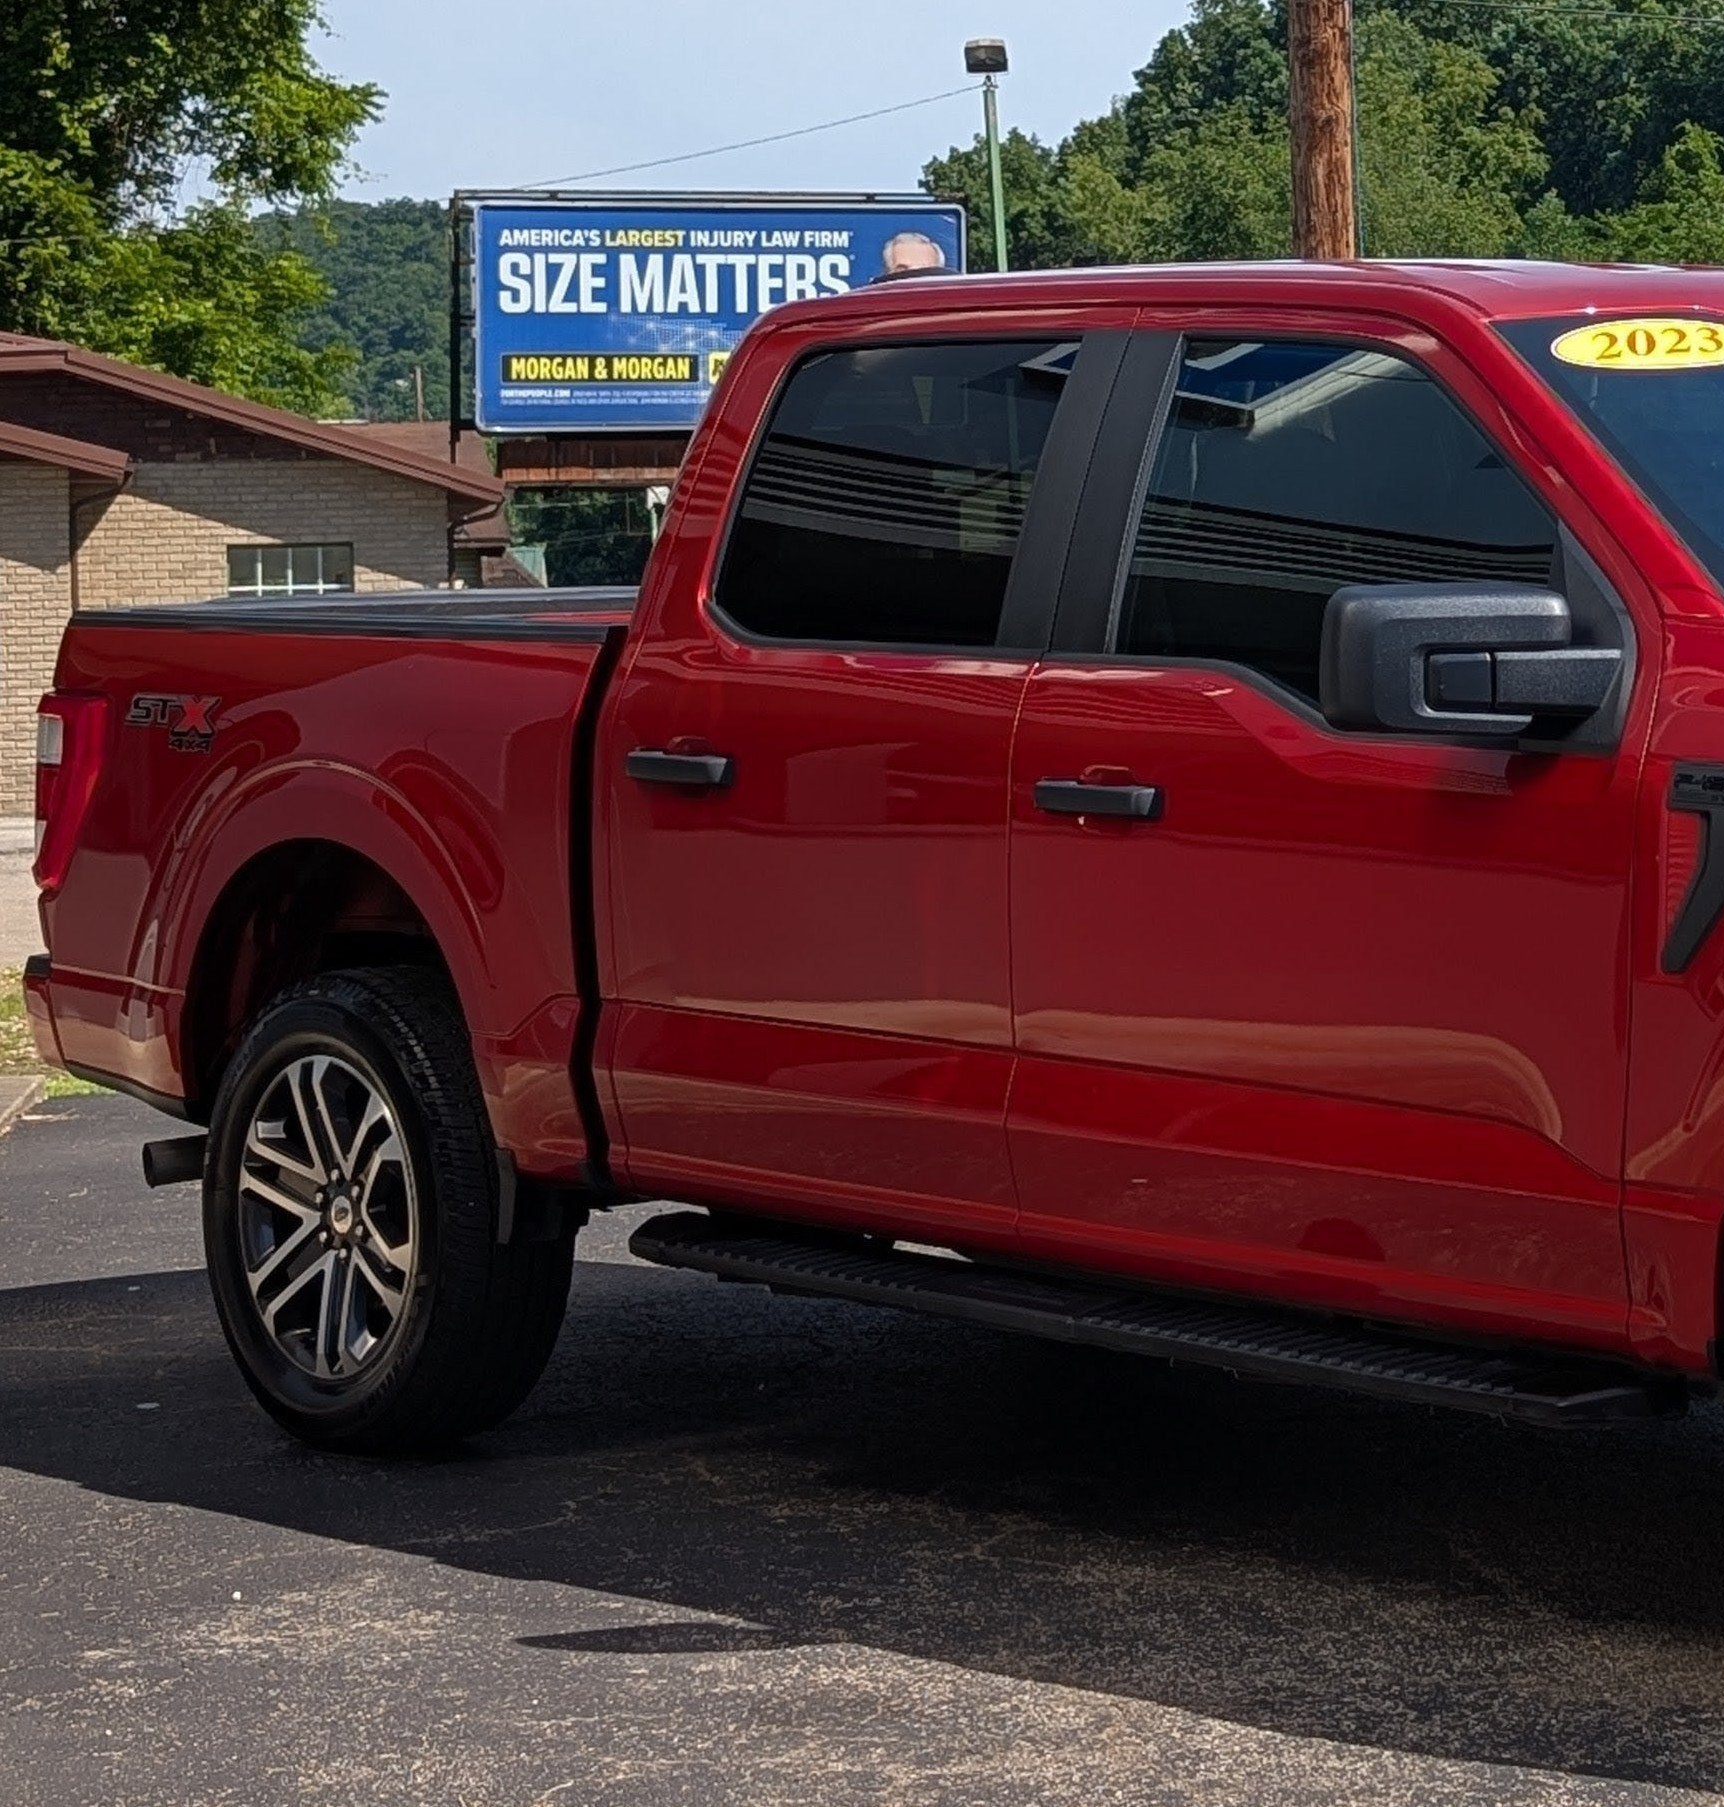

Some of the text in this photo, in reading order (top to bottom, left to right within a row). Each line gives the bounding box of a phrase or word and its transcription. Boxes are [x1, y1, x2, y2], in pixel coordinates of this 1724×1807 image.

[500, 228, 849, 248] AMERICA'S LARGEST INJURY LAW FIRM
[499, 252, 851, 314] SIZE MATTERS
[1591, 326, 1724, 361] 2023
[511, 357, 691, 381] MORGAN & MORGAN
[125, 692, 223, 737] STX
